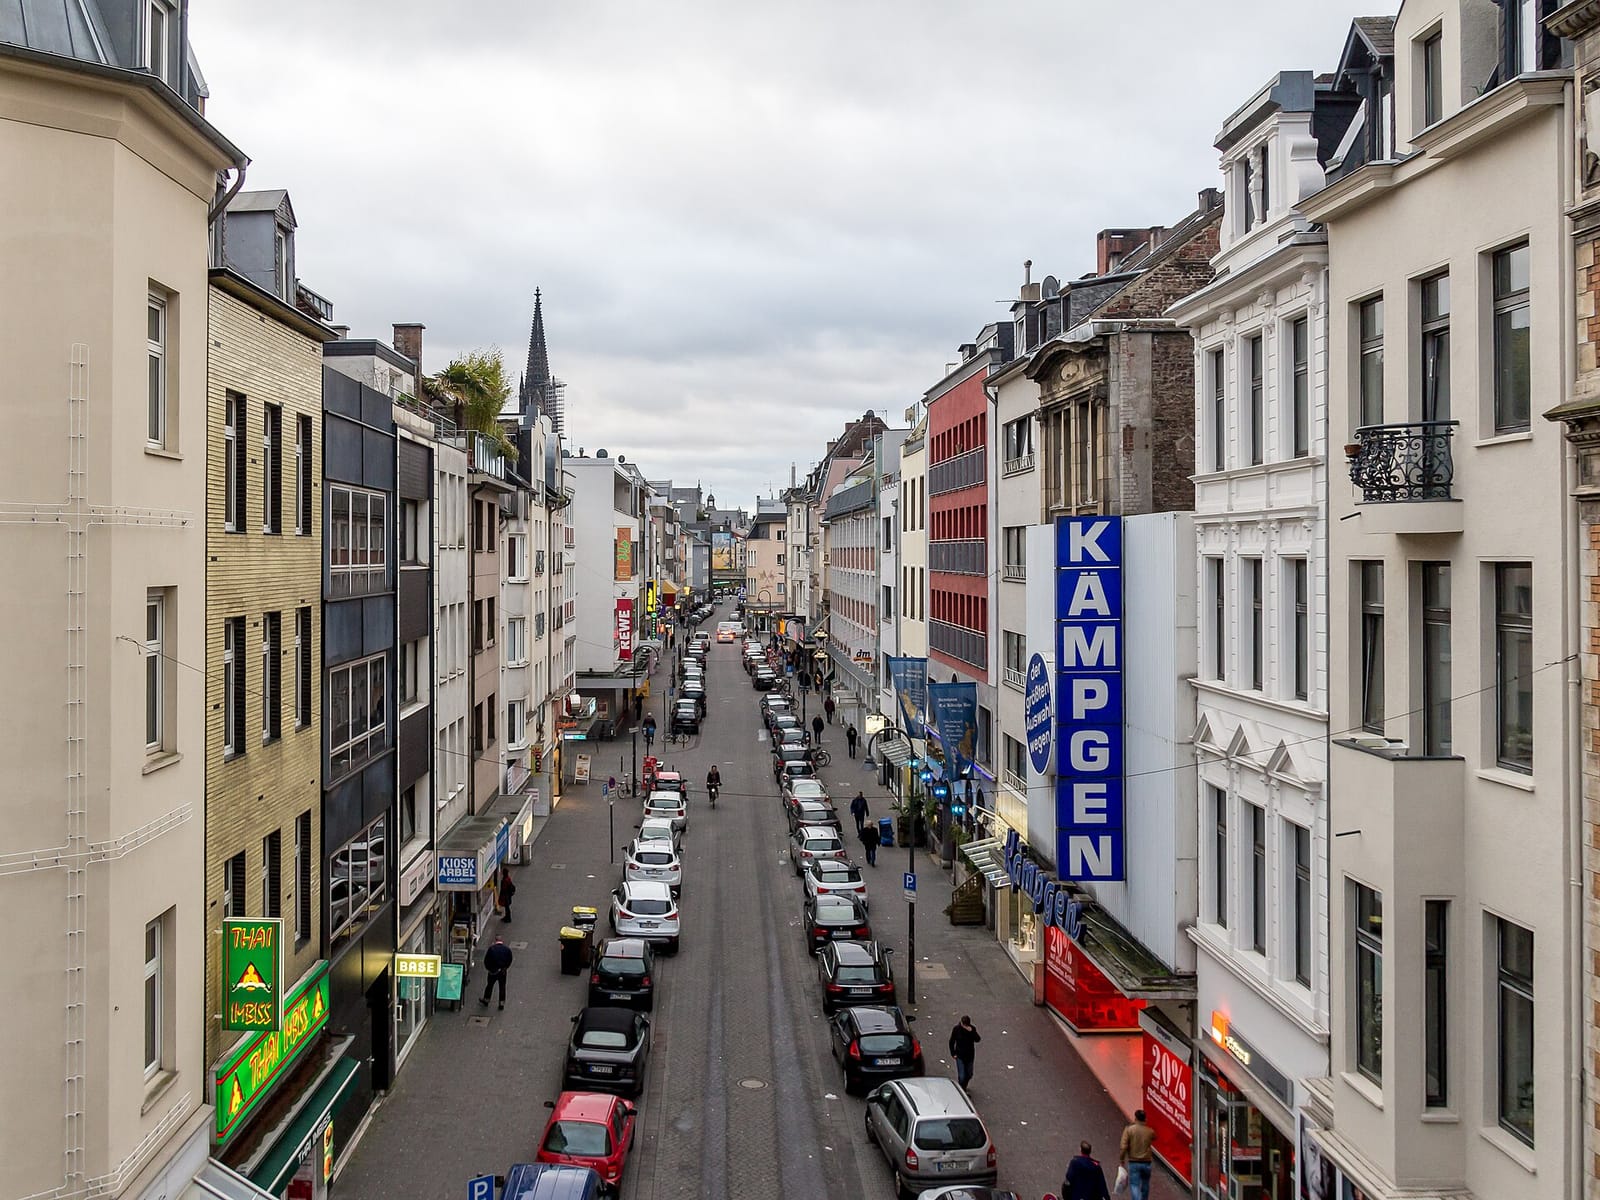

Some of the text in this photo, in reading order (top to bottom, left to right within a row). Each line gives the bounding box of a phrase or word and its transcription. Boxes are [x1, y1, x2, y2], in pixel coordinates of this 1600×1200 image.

[618, 609, 631, 651] REWE
[1030, 662, 1041, 681] der
[1026, 681, 1050, 715] größten
[1063, 521, 1117, 877] KÄMPGEN
[1026, 699, 1051, 733] Auswahl
[1029, 730, 1051, 755] wegen
[439, 868, 476, 877] ARBEL
[442, 858, 475, 869] KIOSK
[906, 874, 914, 888] P
[231, 926, 273, 951] THAI
[1050, 926, 1072, 966] 20%
[399, 961, 435, 973] BASE
[231, 1001, 273, 1025] IMBISS
[249, 999, 309, 1090] THAI IMBISS
[1151, 1044, 1187, 1101] 20%
[474, 1181, 489, 1200] P
